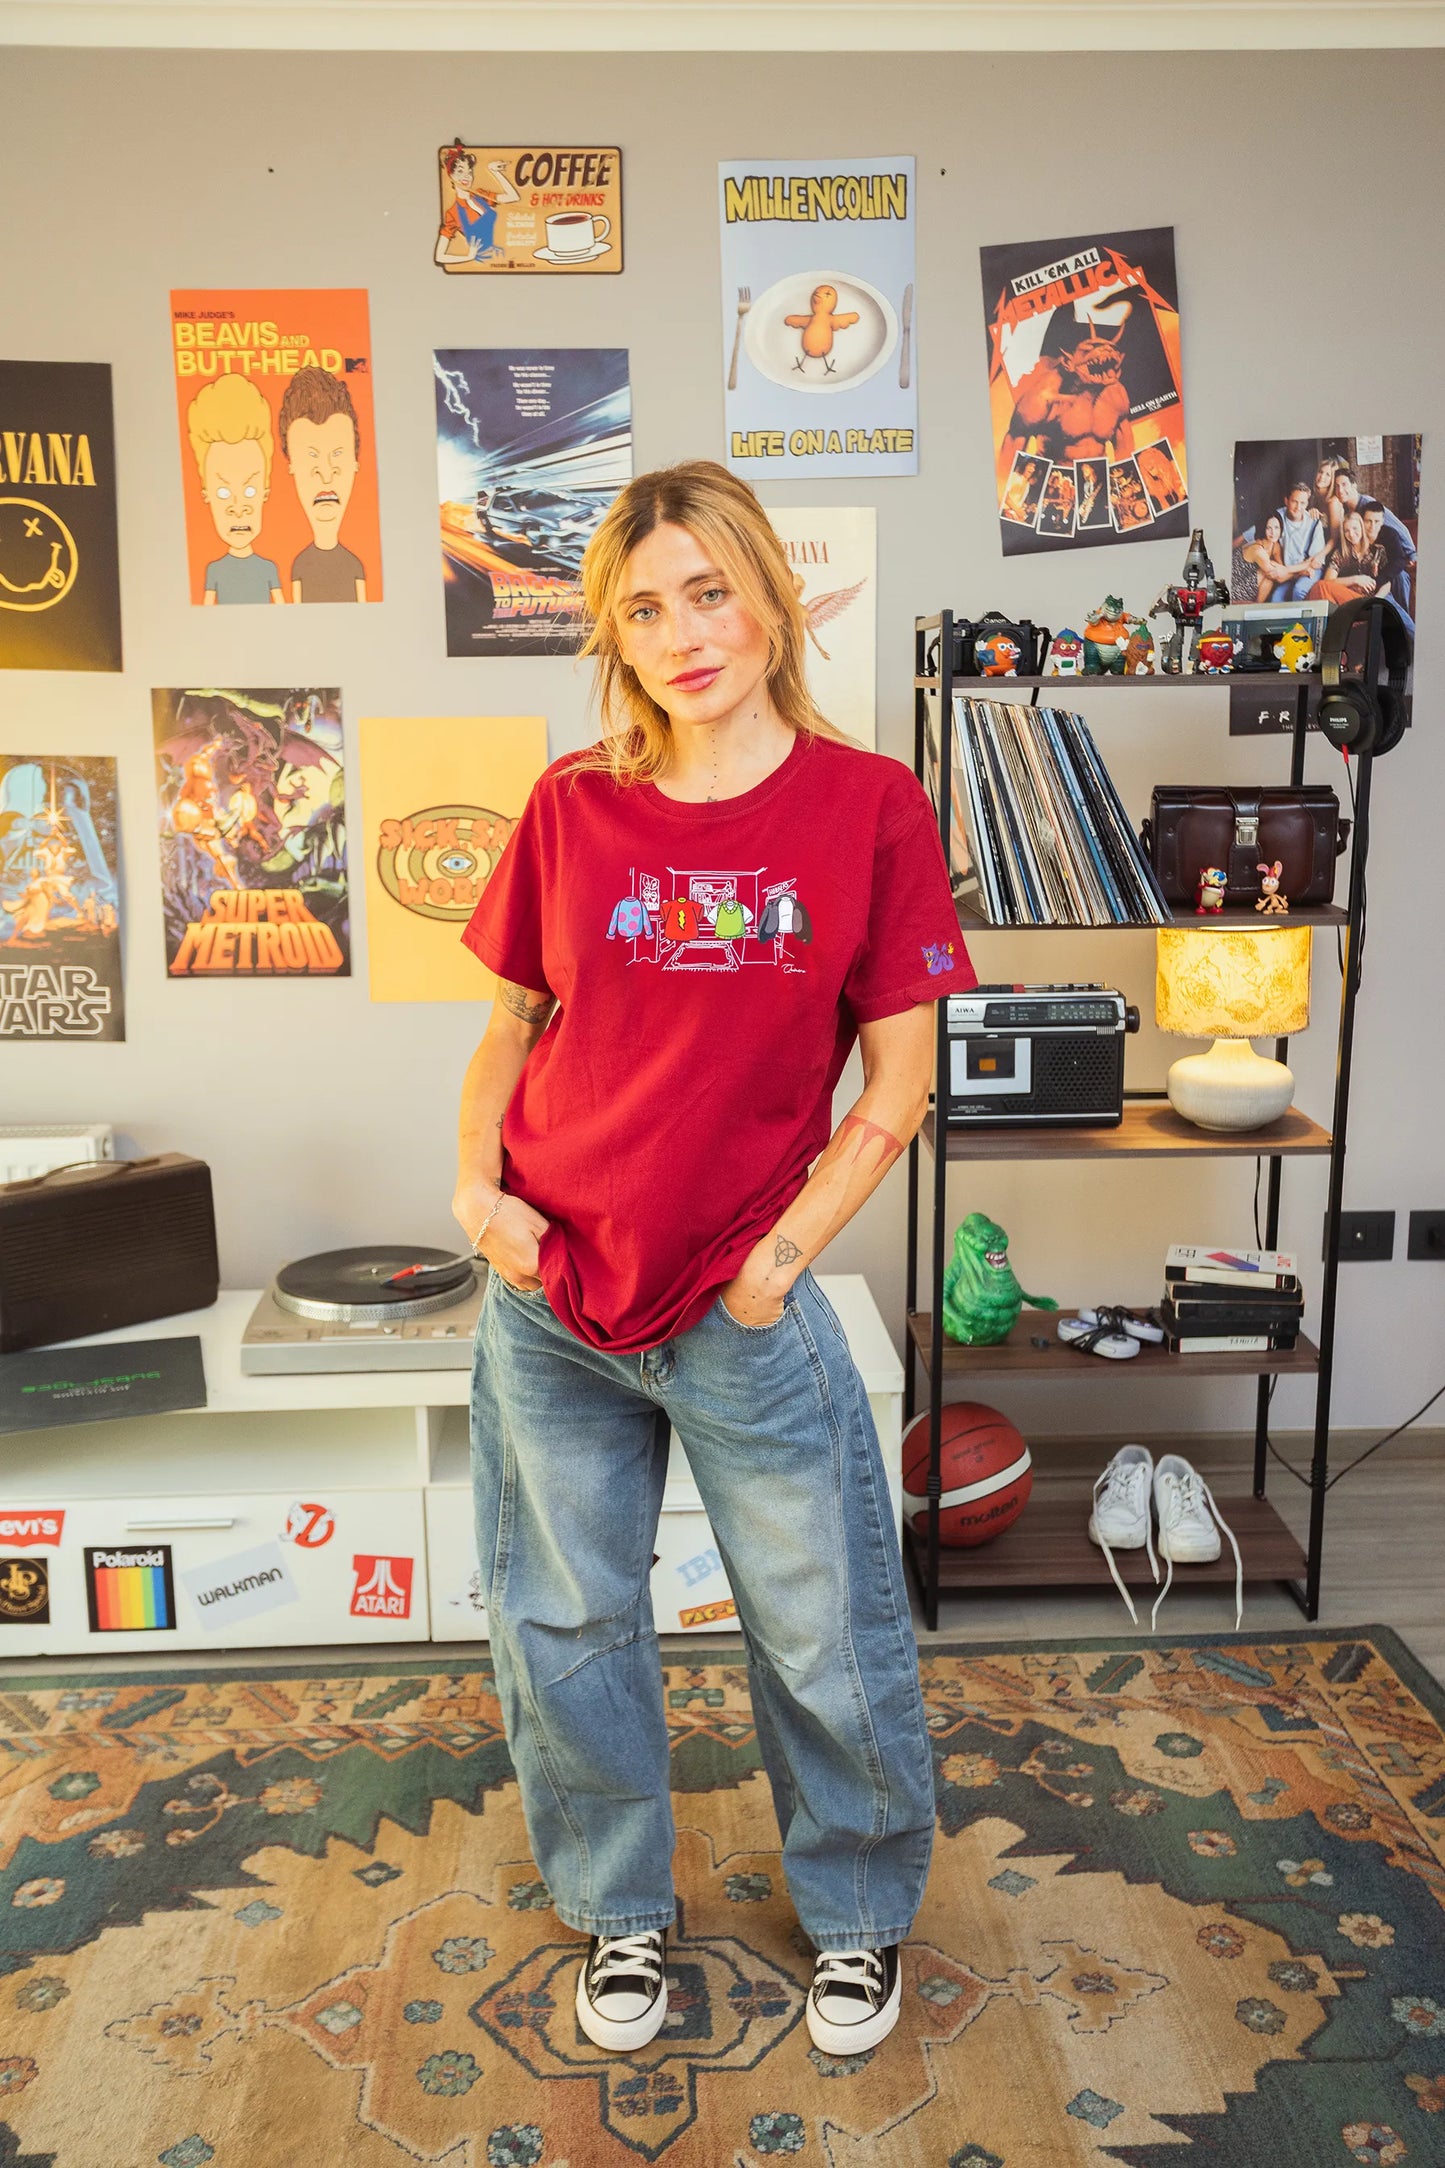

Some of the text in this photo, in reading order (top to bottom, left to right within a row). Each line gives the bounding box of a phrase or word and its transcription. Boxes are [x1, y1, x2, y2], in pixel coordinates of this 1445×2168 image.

[514, 153, 613, 187] COFFEE
[530, 193, 605, 206] & HOT DRINKS
[724, 174, 907, 223] MILLENCOLIN
[1014, 274, 1044, 294] KILL
[1074, 252, 1099, 270] ALL
[988, 247, 1176, 340] METALLICA
[174, 311, 235, 319] MIKE JUDGE'S
[174, 321, 310, 348] BEAVIS AND
[175, 348, 342, 376] BUTT-HEAD
[731, 428, 914, 458] LIFE ON A PLATE
[488, 571, 573, 597] BACK
[493, 597, 512, 609] TO
[983, 617, 1007, 625] Canon
[379, 818, 521, 852] SICK SA
[200, 889, 320, 923] SUPER
[168, 922, 344, 977] METROID
[0, 965, 111, 1000] TAR
[0, 999, 111, 1034] ARS
[0, 1517, 58, 1536] evi's
[961, 1496, 1018, 1527] molten
[92, 1550, 164, 1569] Polaroid
[197, 1567, 283, 1606] WALKMAN
[354, 1595, 405, 1616] ATARI
